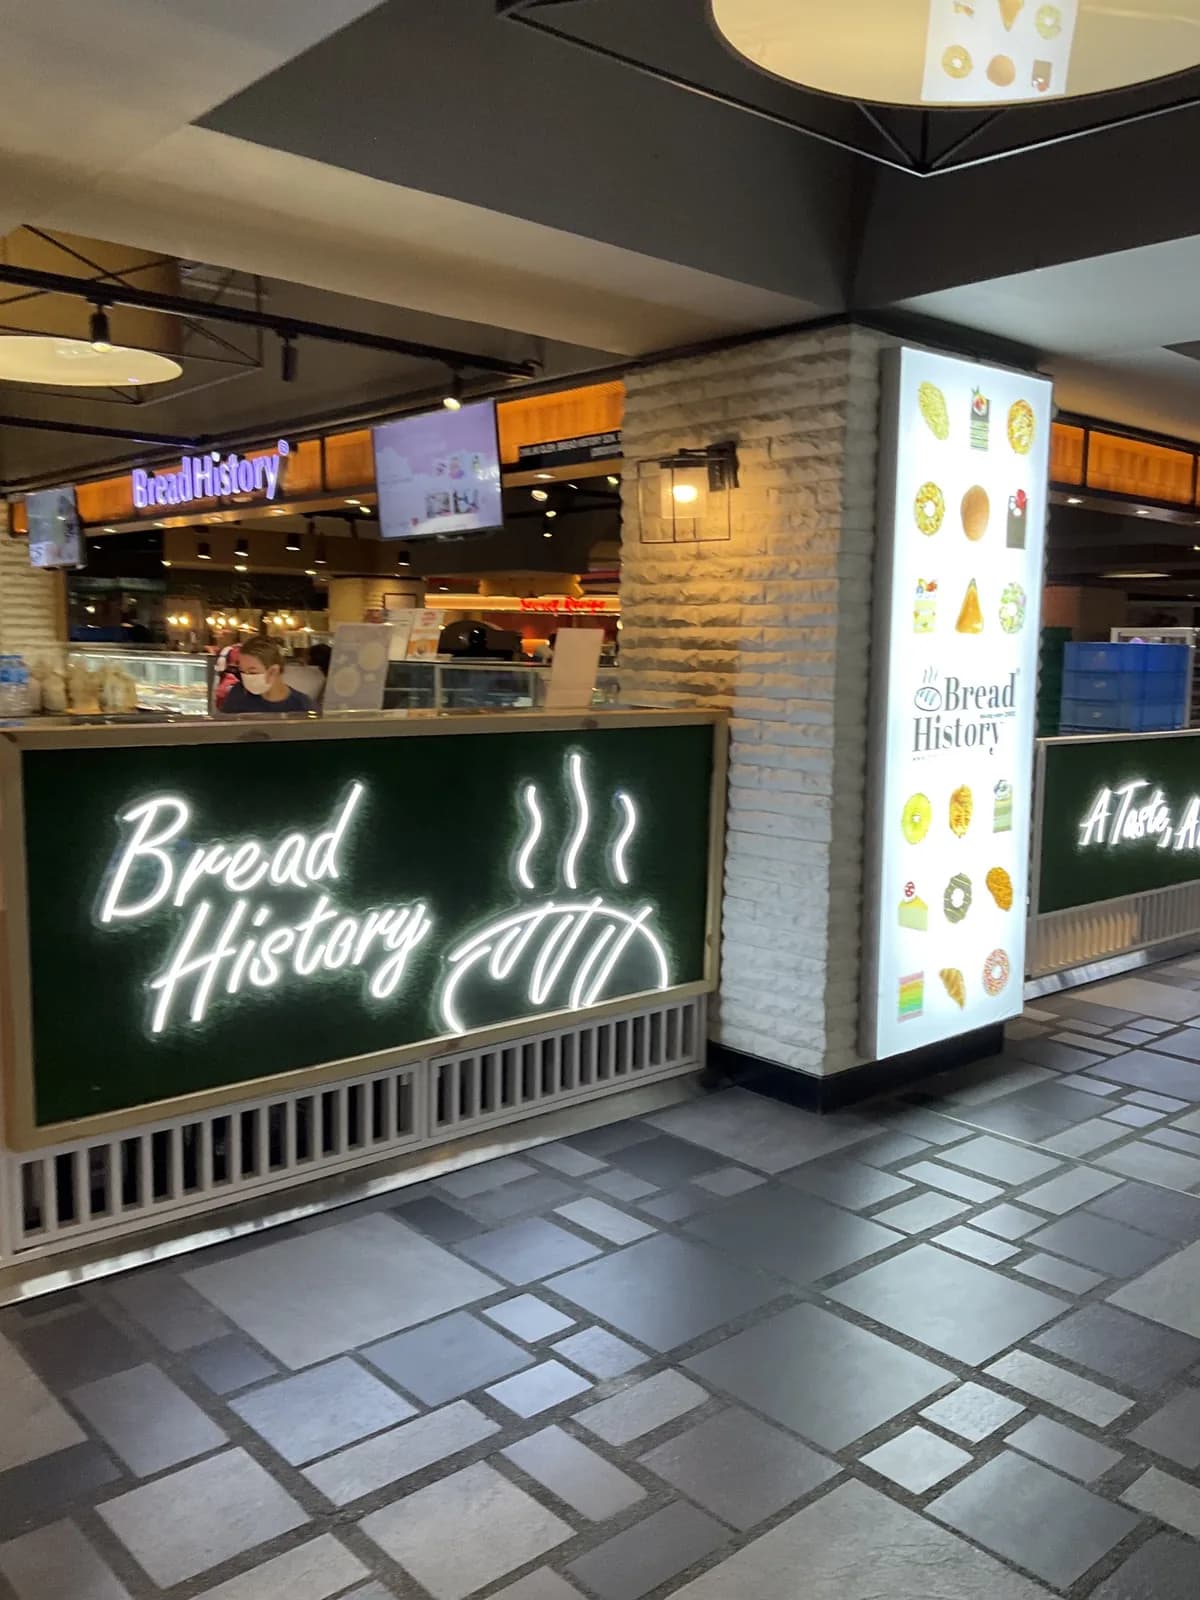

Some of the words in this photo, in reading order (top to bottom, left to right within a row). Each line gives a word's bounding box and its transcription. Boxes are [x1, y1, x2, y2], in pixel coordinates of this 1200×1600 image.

[943, 672, 1016, 711] Bread
[912, 714, 999, 756] History
[1078, 786, 1112, 846] A
[100, 780, 366, 924] Bread
[149, 895, 433, 1035] History
